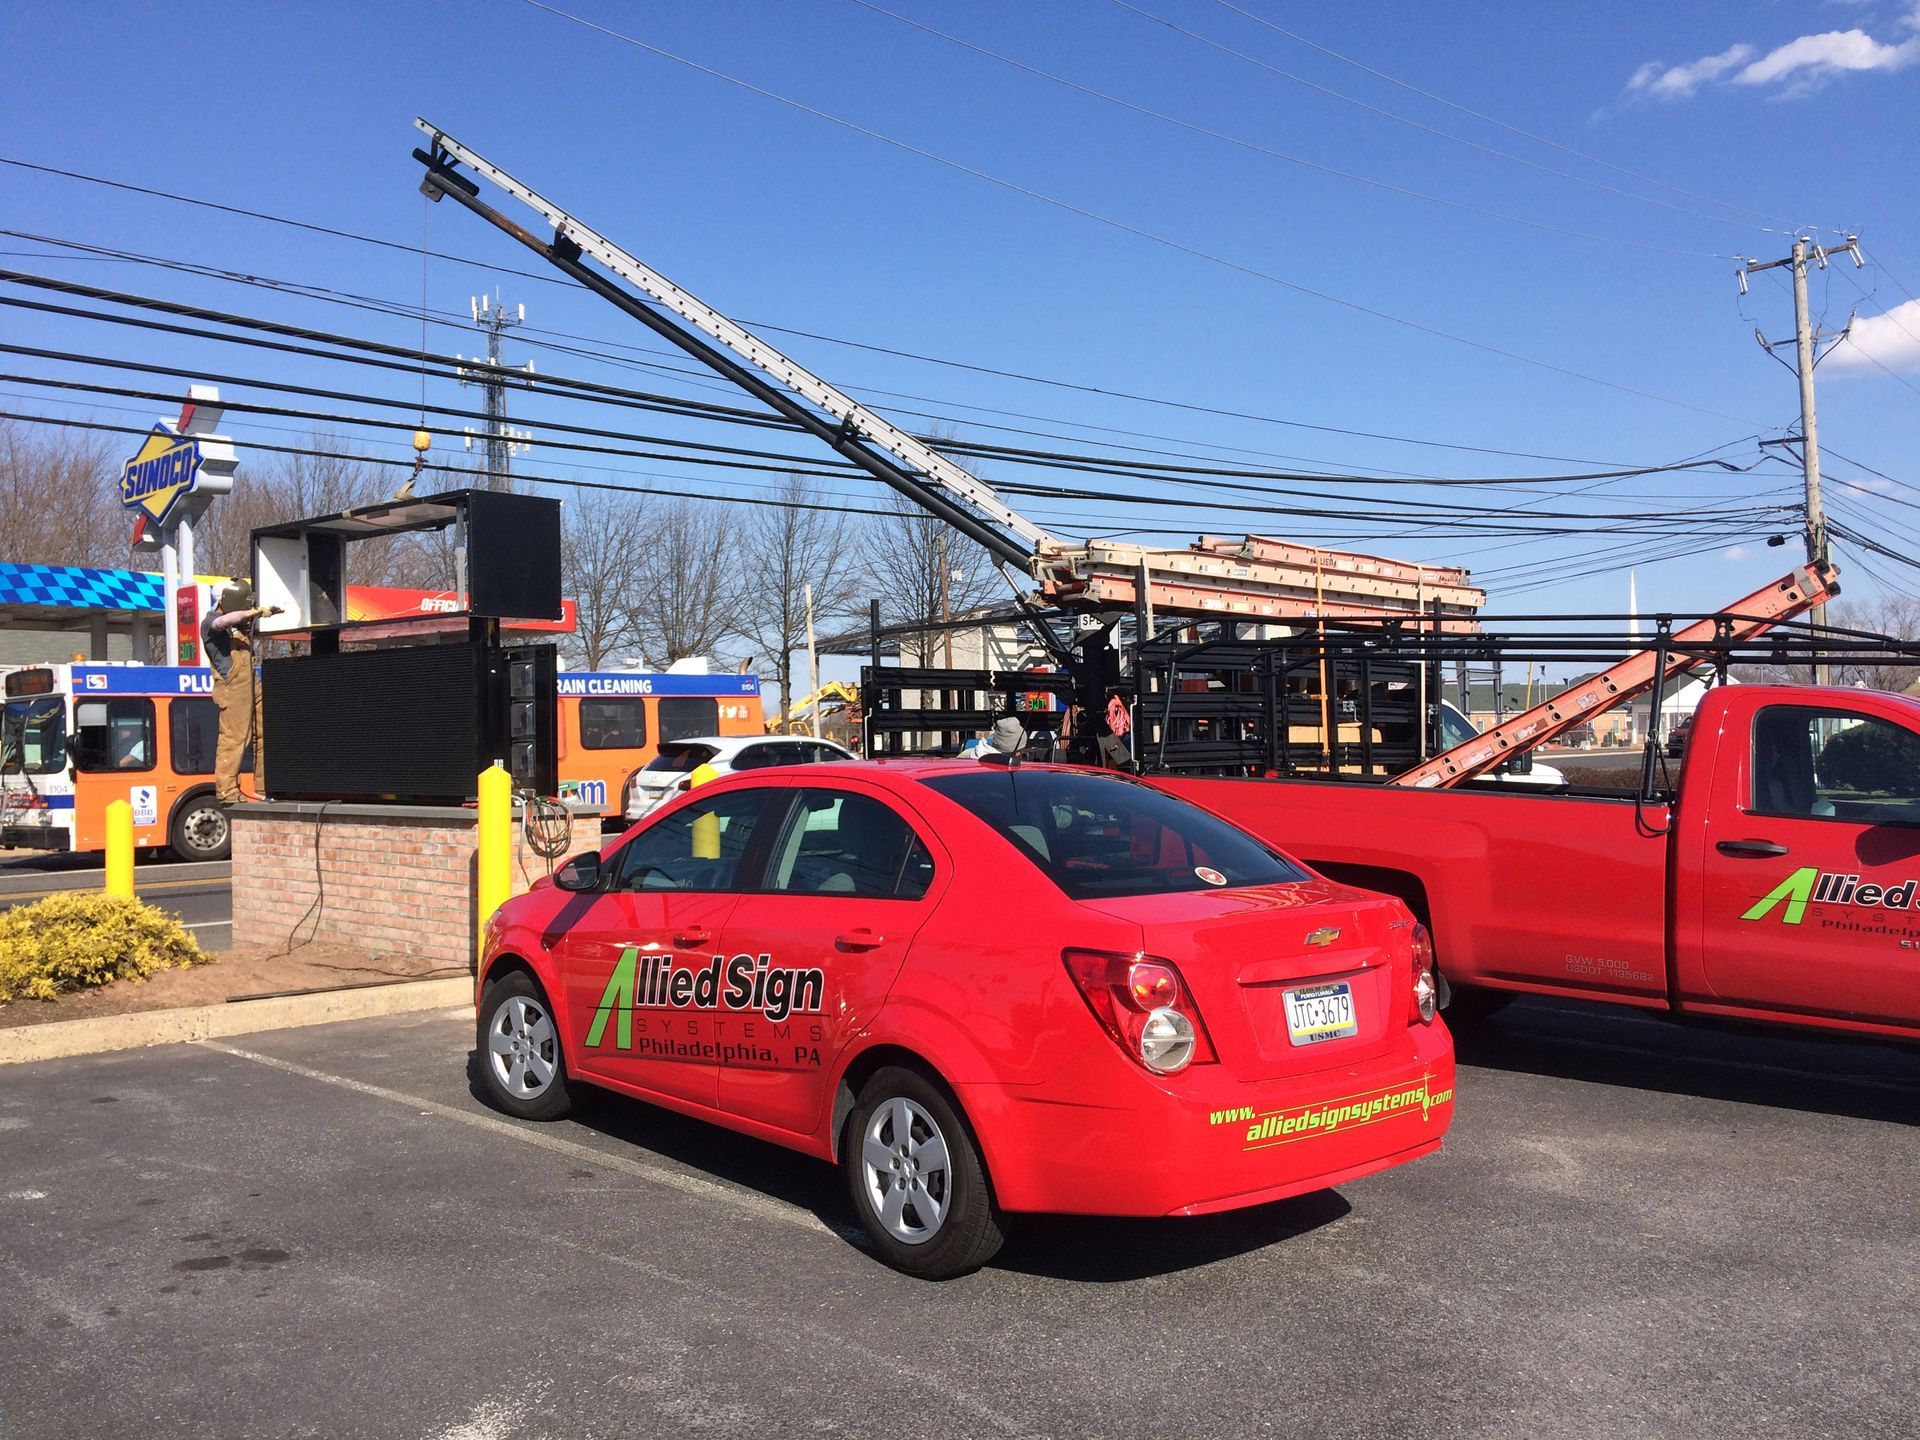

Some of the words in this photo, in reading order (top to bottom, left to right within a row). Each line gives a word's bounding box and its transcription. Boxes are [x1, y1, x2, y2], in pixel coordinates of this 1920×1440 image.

[124, 446, 193, 499] SUNOCO
[588, 679, 652, 694] CLEANING
[1565, 963, 1602, 975] USDOT
[723, 953, 824, 1022] Sign
[636, 1017, 822, 1042] SYSTEMS
[1309, 1029, 1341, 1042] USMC
[639, 1037, 780, 1064] Philadelphia,
[794, 1046, 821, 1066] PA
[1210, 1106, 1256, 1125] www.
